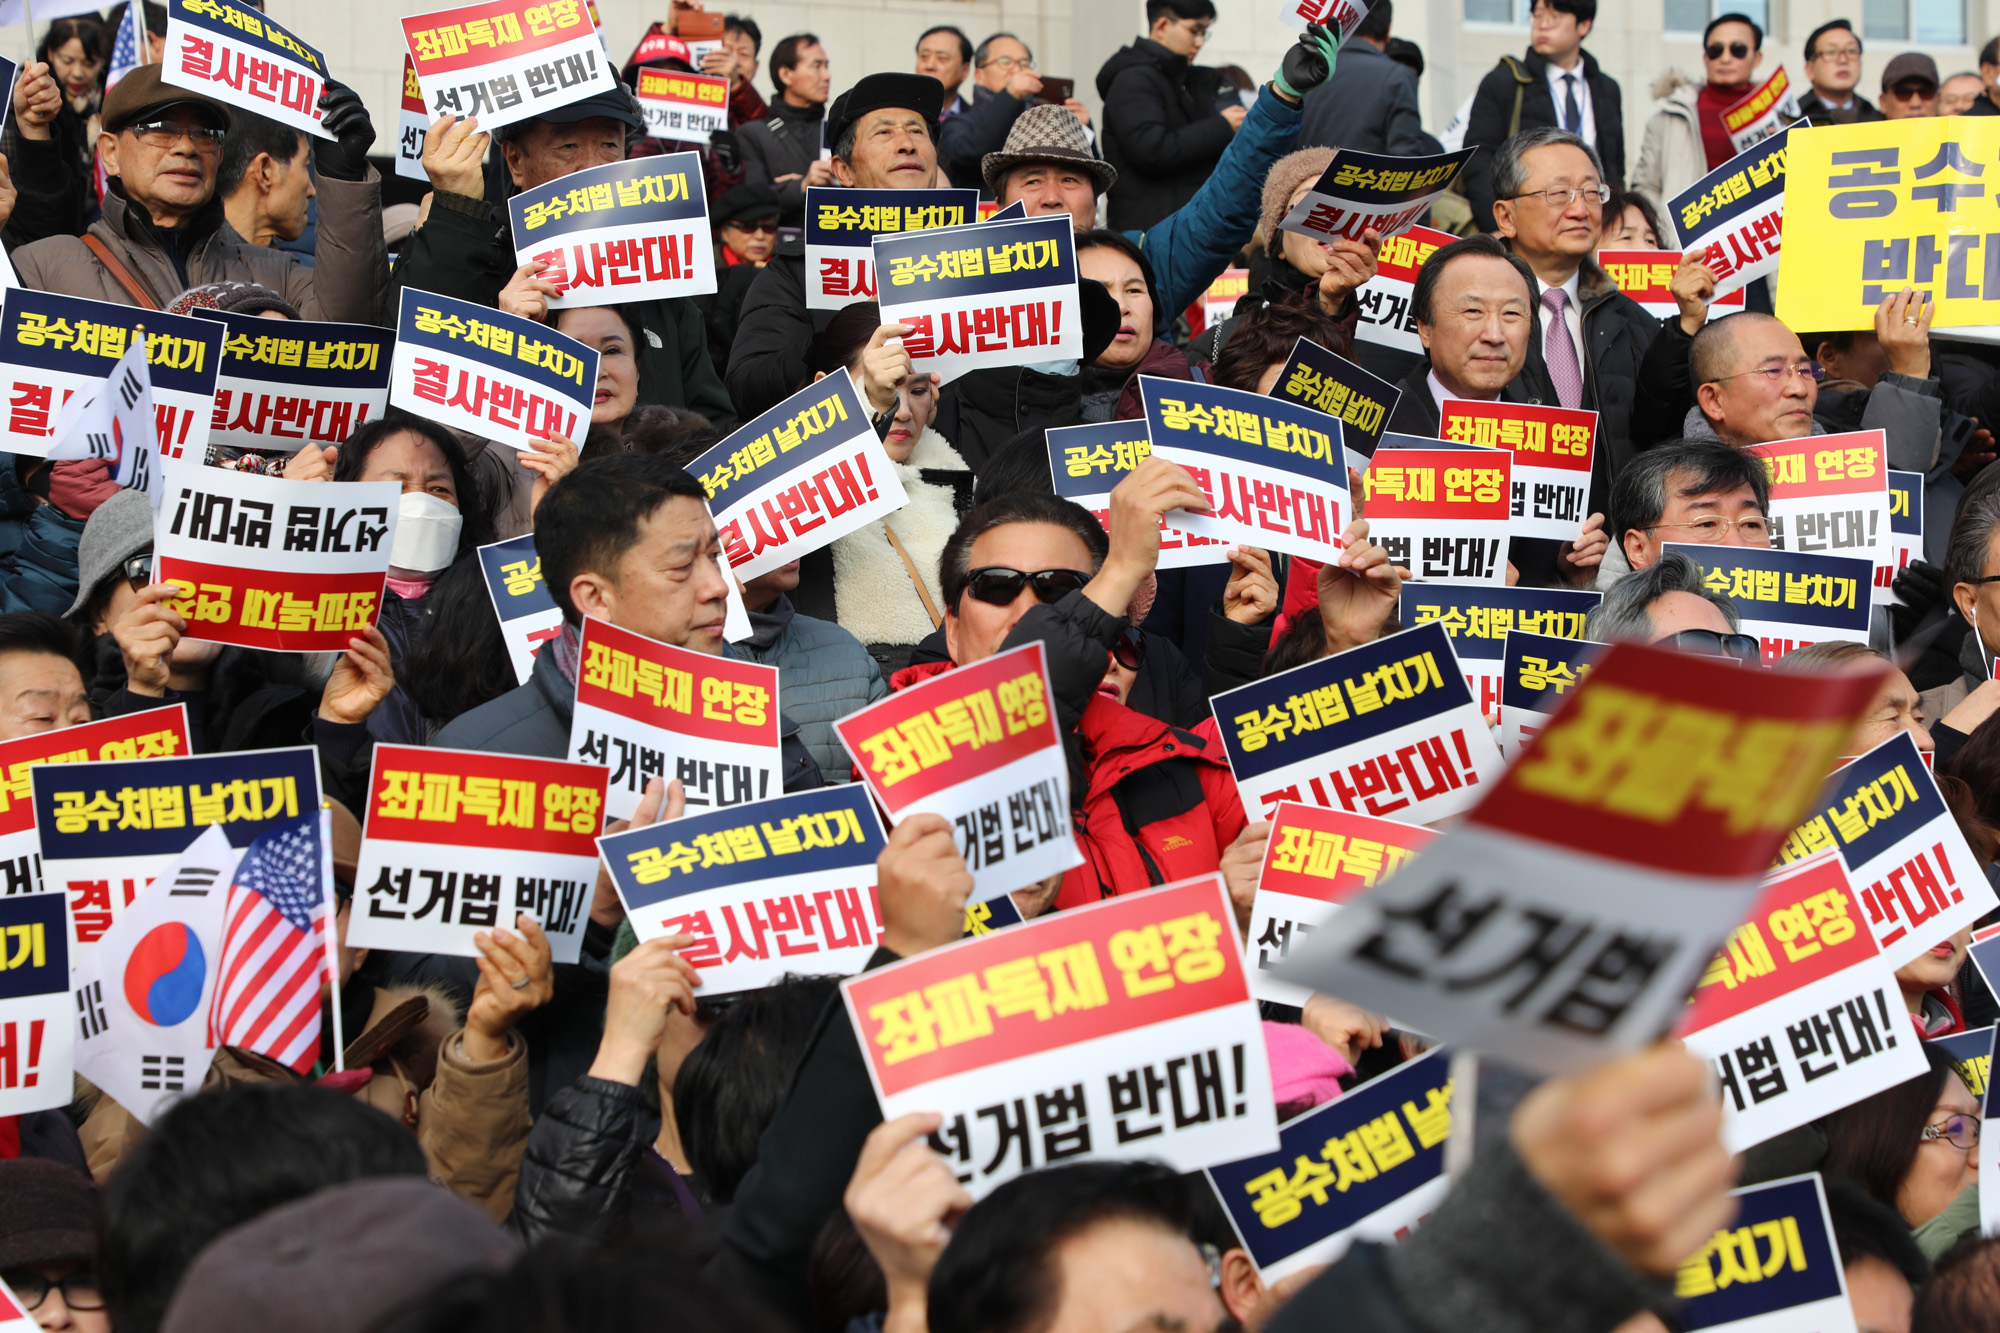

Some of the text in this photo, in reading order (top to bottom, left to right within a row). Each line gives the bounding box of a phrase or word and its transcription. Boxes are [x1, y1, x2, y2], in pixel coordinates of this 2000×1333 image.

[261, 25, 321, 70] 날치기
[413, 12, 523, 61] 좌파독재
[525, 0, 580, 36] 연장
[182, 34, 329, 119] 결사반대!
[435, 73, 524, 122] 선거법
[528, 54, 598, 97] 반대!
[642, 76, 725, 102] 좌파독재 연장
[686, 110, 722, 133] 반대!
[525, 174, 689, 230] 공수처법 날치기
[1334, 162, 1458, 191] 공수처법 날치기
[1681, 171, 1751, 229] 공수처법
[1828, 142, 2000, 219] 공수
[818, 205, 900, 231] 공수처법
[905, 206, 964, 231] 날치기
[532, 234, 693, 296] 결사반대!
[891, 240, 1059, 285] 공수처법 날치기
[17, 312, 126, 359] 공수처법
[306, 341, 379, 370] 날치기
[415, 307, 584, 385] 공수처법 날치기
[901, 301, 1061, 358] 결사반대!
[413, 358, 577, 444] 결사반대!
[773, 395, 848, 452] 날치기
[1286, 363, 1385, 436] 공수처법 날치기
[1160, 399, 1333, 464] 공수처법 날치기
[1446, 416, 1590, 456] 좌파독재 연장
[1444, 468, 1504, 502] 연장
[1815, 447, 1878, 481] 연장
[170, 489, 388, 552] 선거법 반대!
[719, 452, 879, 568] 결사반대!
[1534, 484, 1583, 522] 반대!
[1797, 510, 1878, 551] 반대!
[1423, 538, 1499, 578] 반대!
[1701, 567, 1856, 609] 수처법 날치기
[240, 589, 376, 631] 좌파독재
[585, 641, 692, 714] 좌파독재
[702, 677, 769, 726] 연장
[1235, 683, 1349, 752] 공수처법
[1346, 652, 1444, 714] 날치기
[860, 672, 1046, 787] 좌파독재 연장
[54, 776, 298, 833] 공수처법 날치기
[379, 770, 601, 833] 좌파독재 연장
[677, 756, 769, 808] 반대!
[1830, 765, 1919, 843] 날치기
[628, 809, 865, 883] 공수처법 날치기
[1007, 777, 1066, 855] 반대!
[368, 867, 589, 938] 선거법 반대!
[662, 886, 886, 969] 결사반대!
[1769, 888, 1855, 962] 연장
[870, 942, 1108, 1064] 좌파독재
[1111, 913, 1223, 995] 연장
[1787, 989, 1896, 1082] 반대!
[930, 1045, 1245, 1182] 선거법 반대!
[1246, 1111, 1415, 1228] 공수처법
